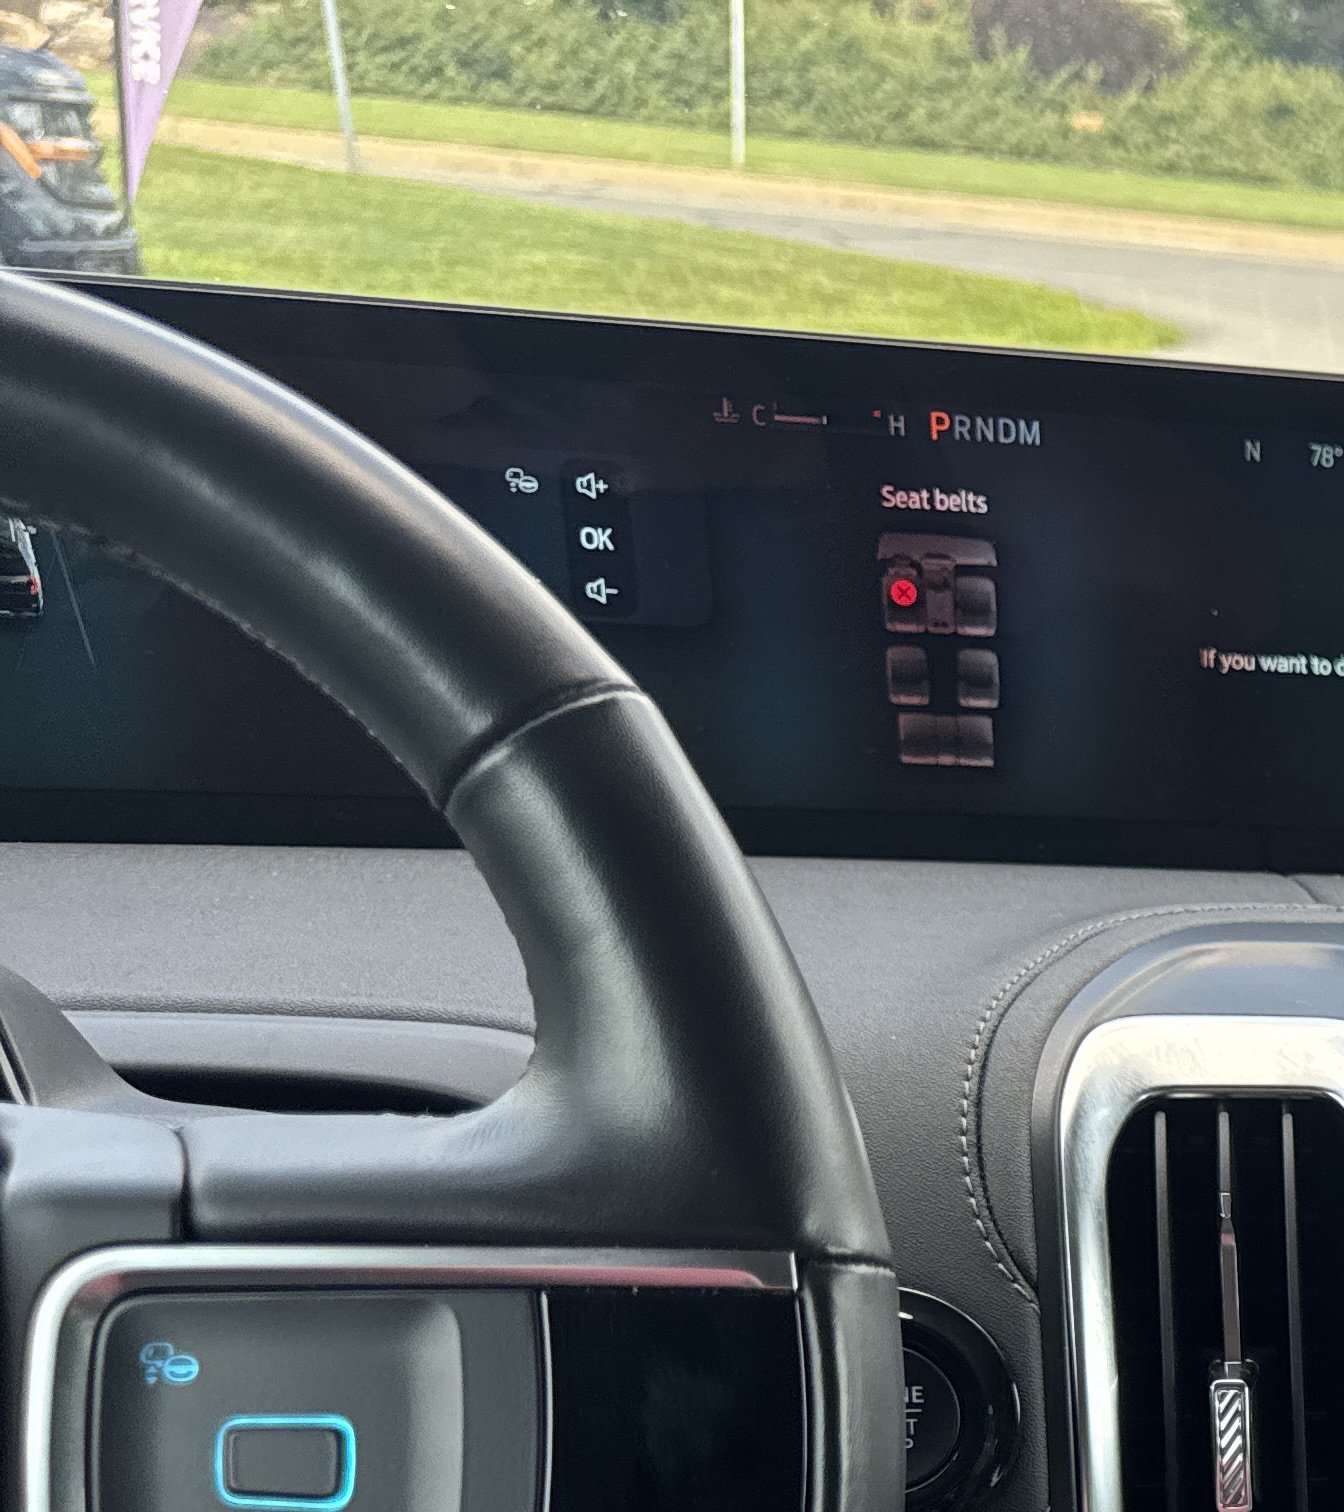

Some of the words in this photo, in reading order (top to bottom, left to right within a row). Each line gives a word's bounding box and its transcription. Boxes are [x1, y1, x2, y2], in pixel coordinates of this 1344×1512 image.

[889, 415, 906, 437] H
[1245, 440, 1261, 462] N
[1309, 443, 1344, 469] 78°
[881, 486, 931, 510] Seat
[934, 488, 988, 514] belts
[580, 526, 614, 551] OK
[1200, 648, 1217, 668] If
[1219, 652, 1255, 674] you
[1257, 653, 1308, 675] want
[1309, 654, 1332, 676] to
